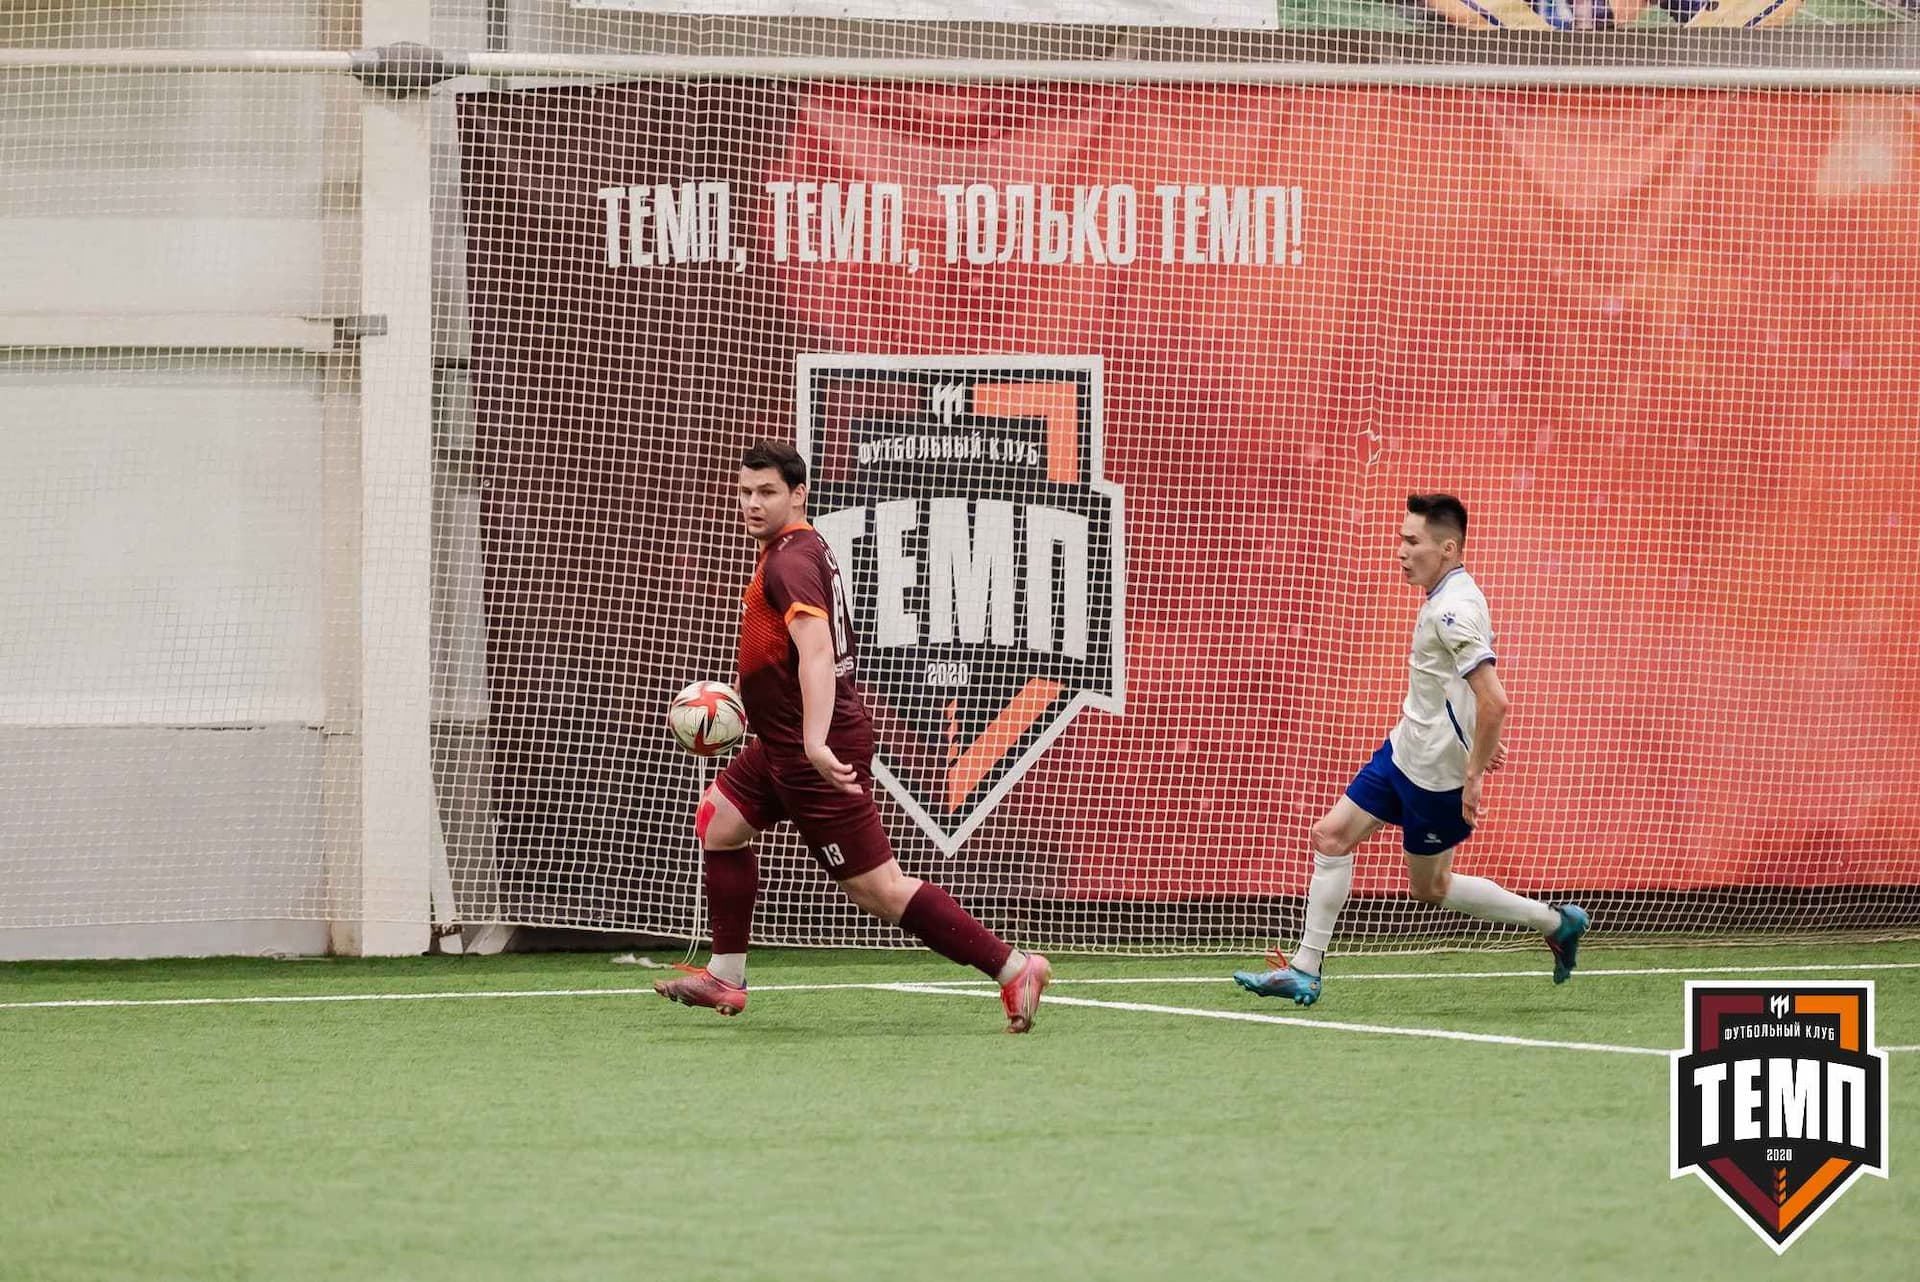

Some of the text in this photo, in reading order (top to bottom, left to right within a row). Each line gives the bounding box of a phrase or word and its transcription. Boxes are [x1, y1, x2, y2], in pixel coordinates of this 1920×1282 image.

[598, 181, 1302, 273] ТЕМП, ТЕМП, ТОЛЬКО ТЕМП!
[858, 431, 1038, 465] ФУТБОЛЬНЫЙ КЛУБ
[927, 663, 969, 686] 2020
[821, 843, 845, 867] 13
